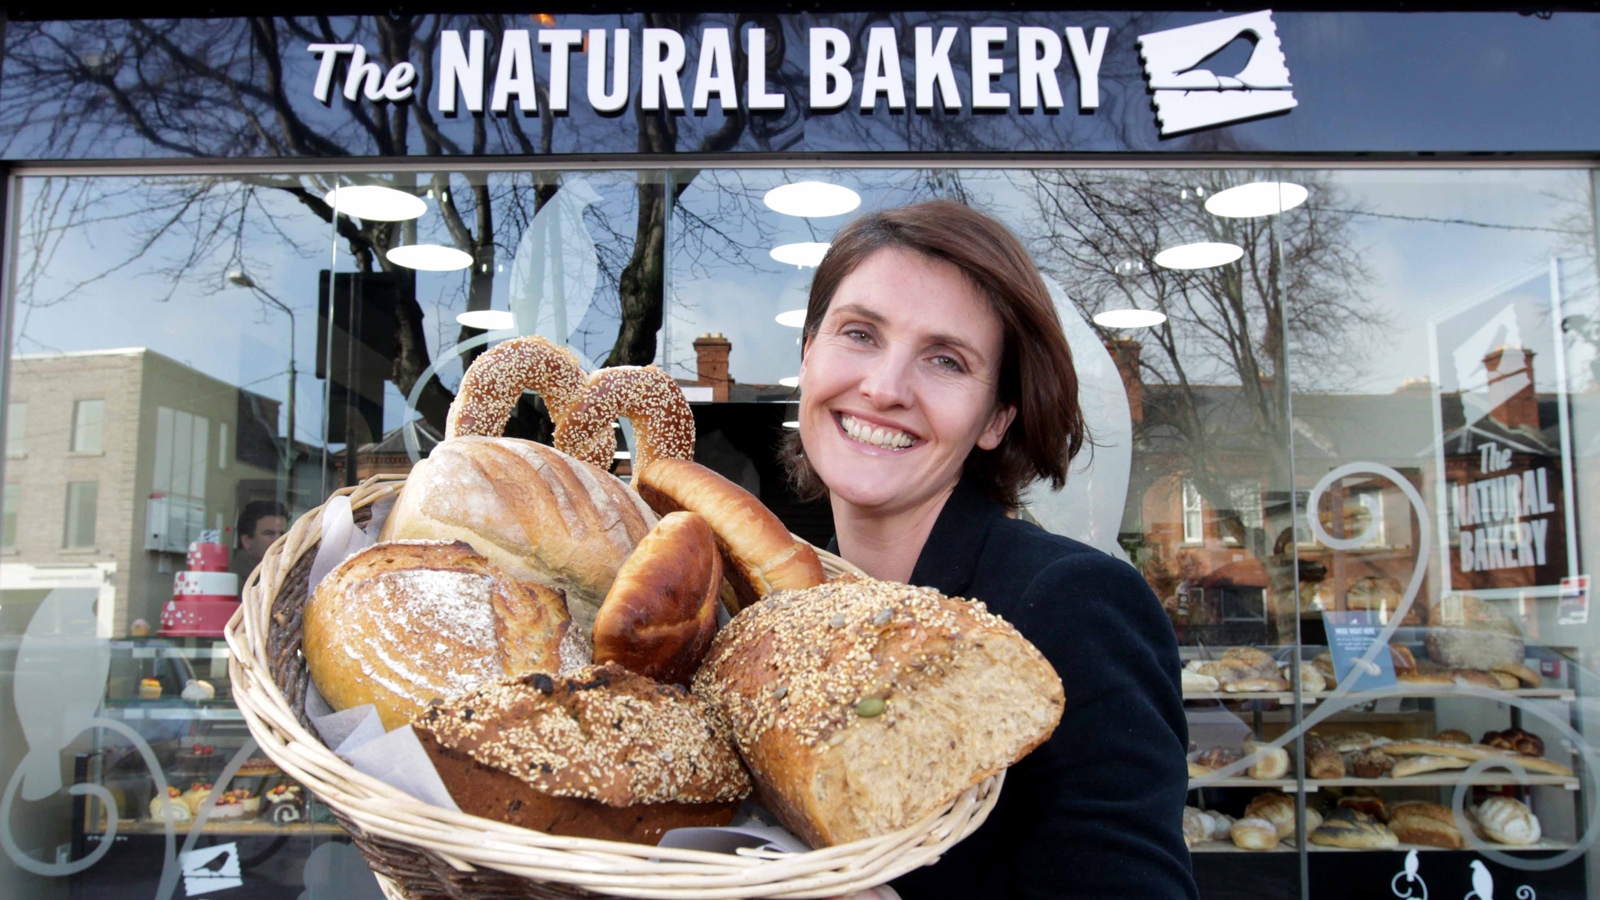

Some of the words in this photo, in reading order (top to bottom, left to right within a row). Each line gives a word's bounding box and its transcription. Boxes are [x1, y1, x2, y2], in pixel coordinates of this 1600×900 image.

[306, 43, 416, 102] The
[438, 28, 786, 112] NATURAL
[809, 26, 1110, 109] BAKERY
[1477, 442, 1512, 474] The
[1452, 467, 1555, 528] NATURAL
[1460, 519, 1548, 573] BAKERY
